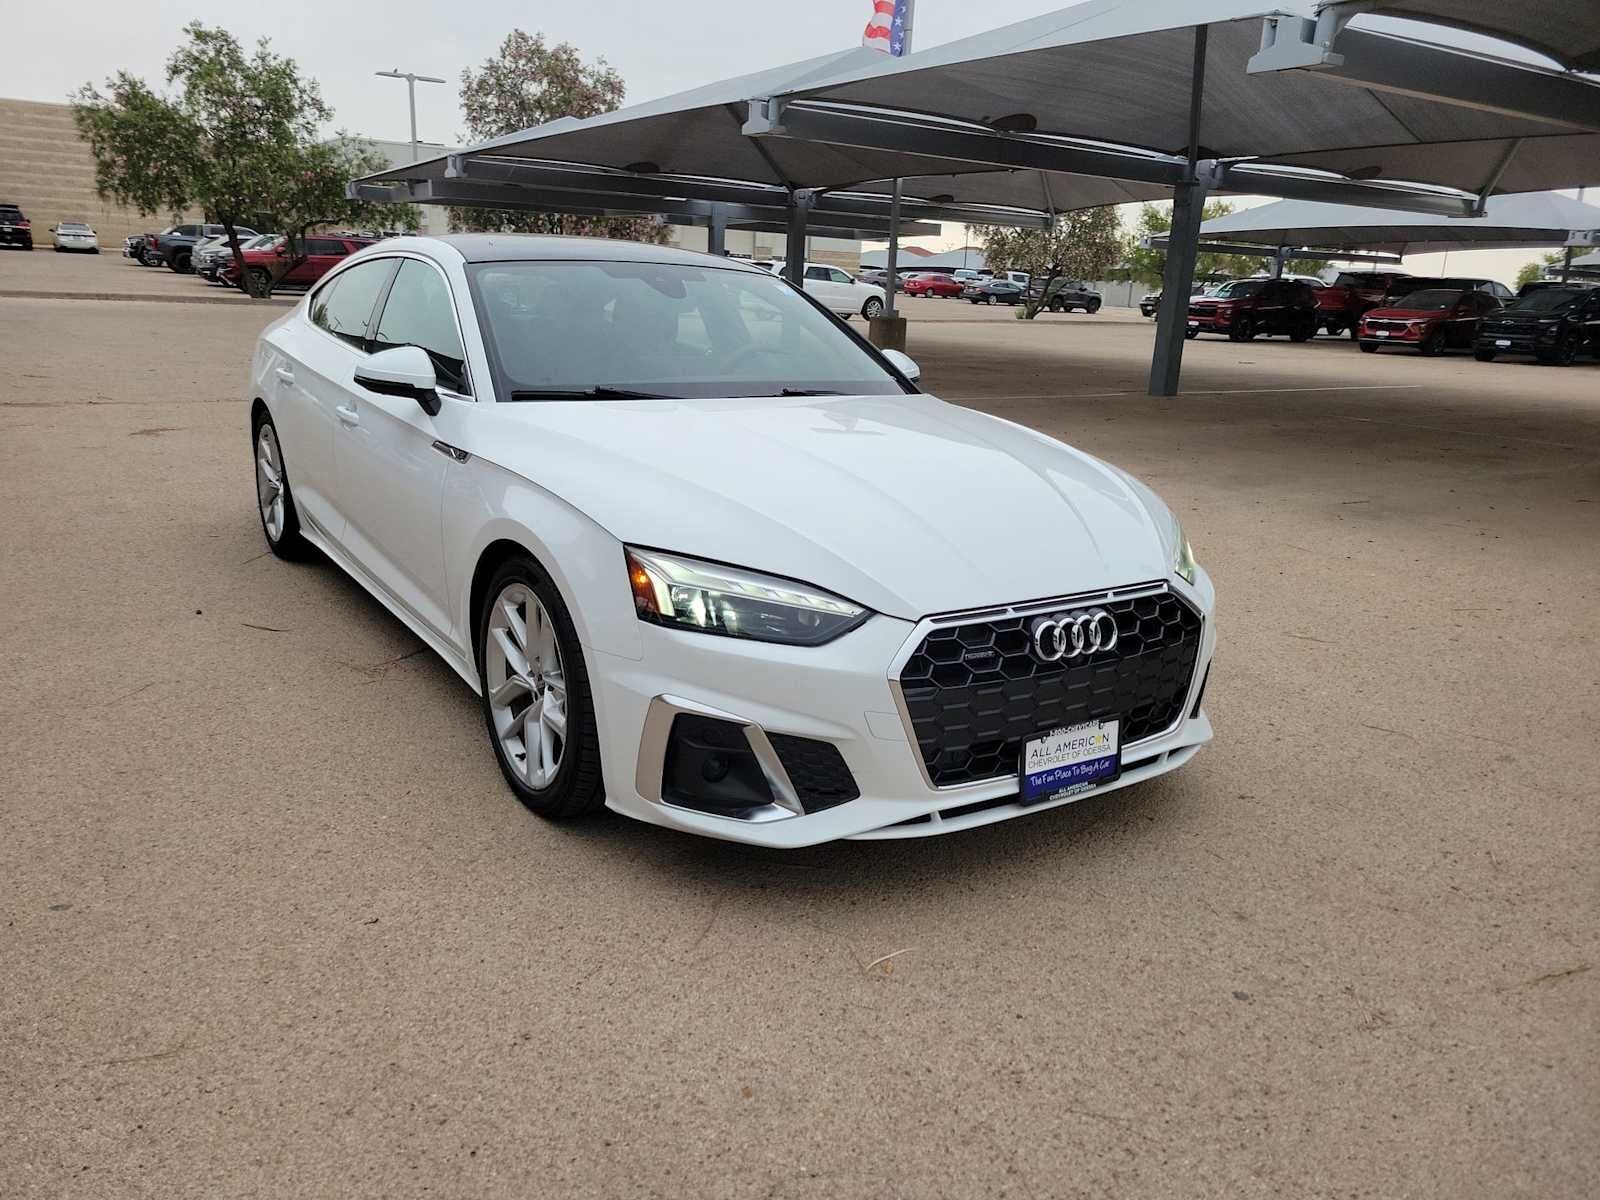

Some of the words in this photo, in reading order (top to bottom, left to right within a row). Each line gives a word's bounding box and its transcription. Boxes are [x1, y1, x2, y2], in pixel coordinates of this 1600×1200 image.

[1028, 752, 1070, 769] CHEVROLET
[1072, 750, 1081, 759] OF
[1083, 744, 1111, 756] ODESSA
[1031, 746, 1051, 760] ALL
[1030, 776, 1042, 787] The
[1042, 773, 1055, 784] Fun
[1055, 768, 1072, 780] Place
[1072, 766, 1080, 775] To
[1080, 764, 1094, 775] Buy
